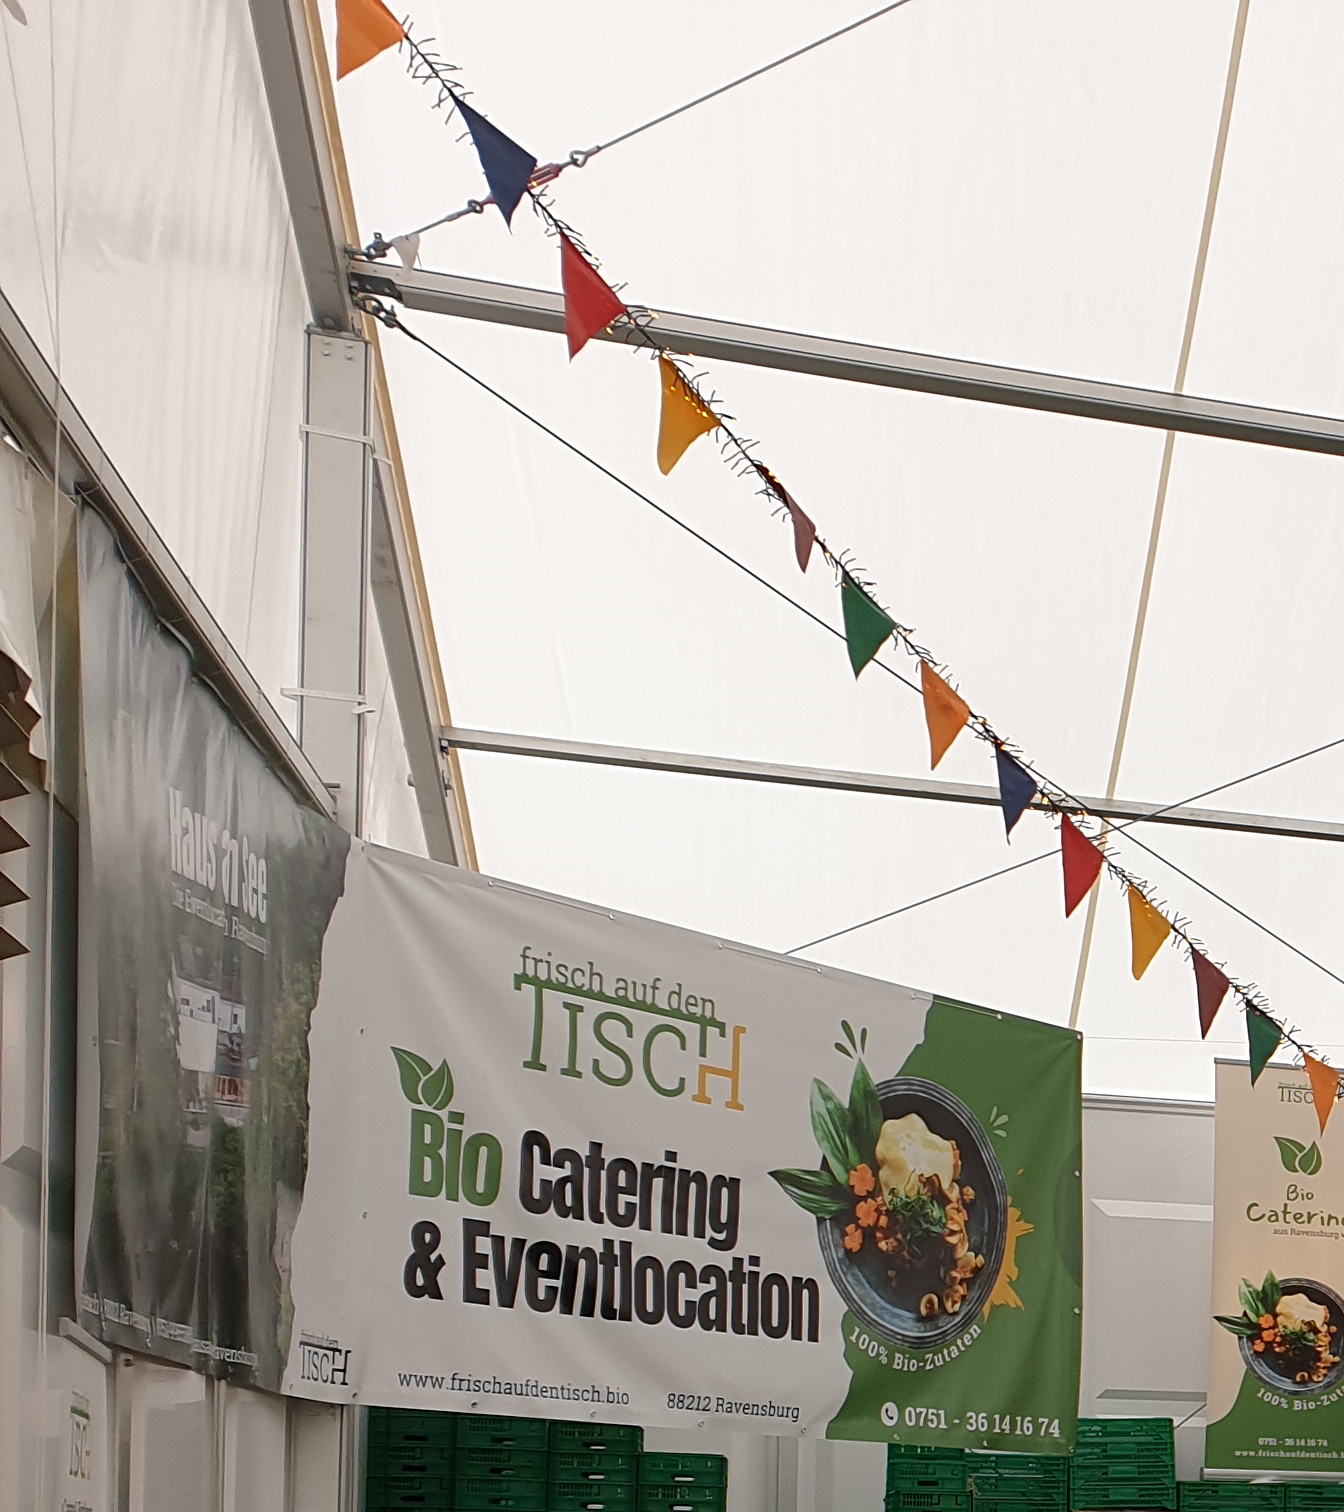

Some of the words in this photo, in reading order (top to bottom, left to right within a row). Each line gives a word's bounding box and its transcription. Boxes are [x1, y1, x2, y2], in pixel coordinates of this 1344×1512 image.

[519, 946, 604, 991] frisch
[614, 977, 662, 1006] auf
[667, 983, 717, 1019] den
[514, 973, 747, 1112] TISCH
[1278, 1086, 1313, 1104] TISC
[409, 1108, 503, 1207] Bio
[519, 1130, 741, 1252] Catering
[1287, 1184, 1314, 1201] Bio
[1290, 1228, 1339, 1240] Ravensburg
[403, 1220, 446, 1301] &
[462, 1217, 820, 1343] Eventlocation
[850, 1326, 888, 1364] 100%
[892, 1323, 982, 1372] Bio-Zutaten
[398, 1372, 630, 1406] www.frischaufdentisch.bio
[667, 1393, 712, 1413] 88212
[715, 1397, 800, 1423] Ravensburg
[1256, 1388, 1288, 1409] 100%
[904, 1407, 947, 1429] 0751
[966, 1412, 988, 1432] 36
[993, 1414, 1010, 1434] 14
[1015, 1416, 1033, 1436] 16
[1039, 1418, 1061, 1438] 74
